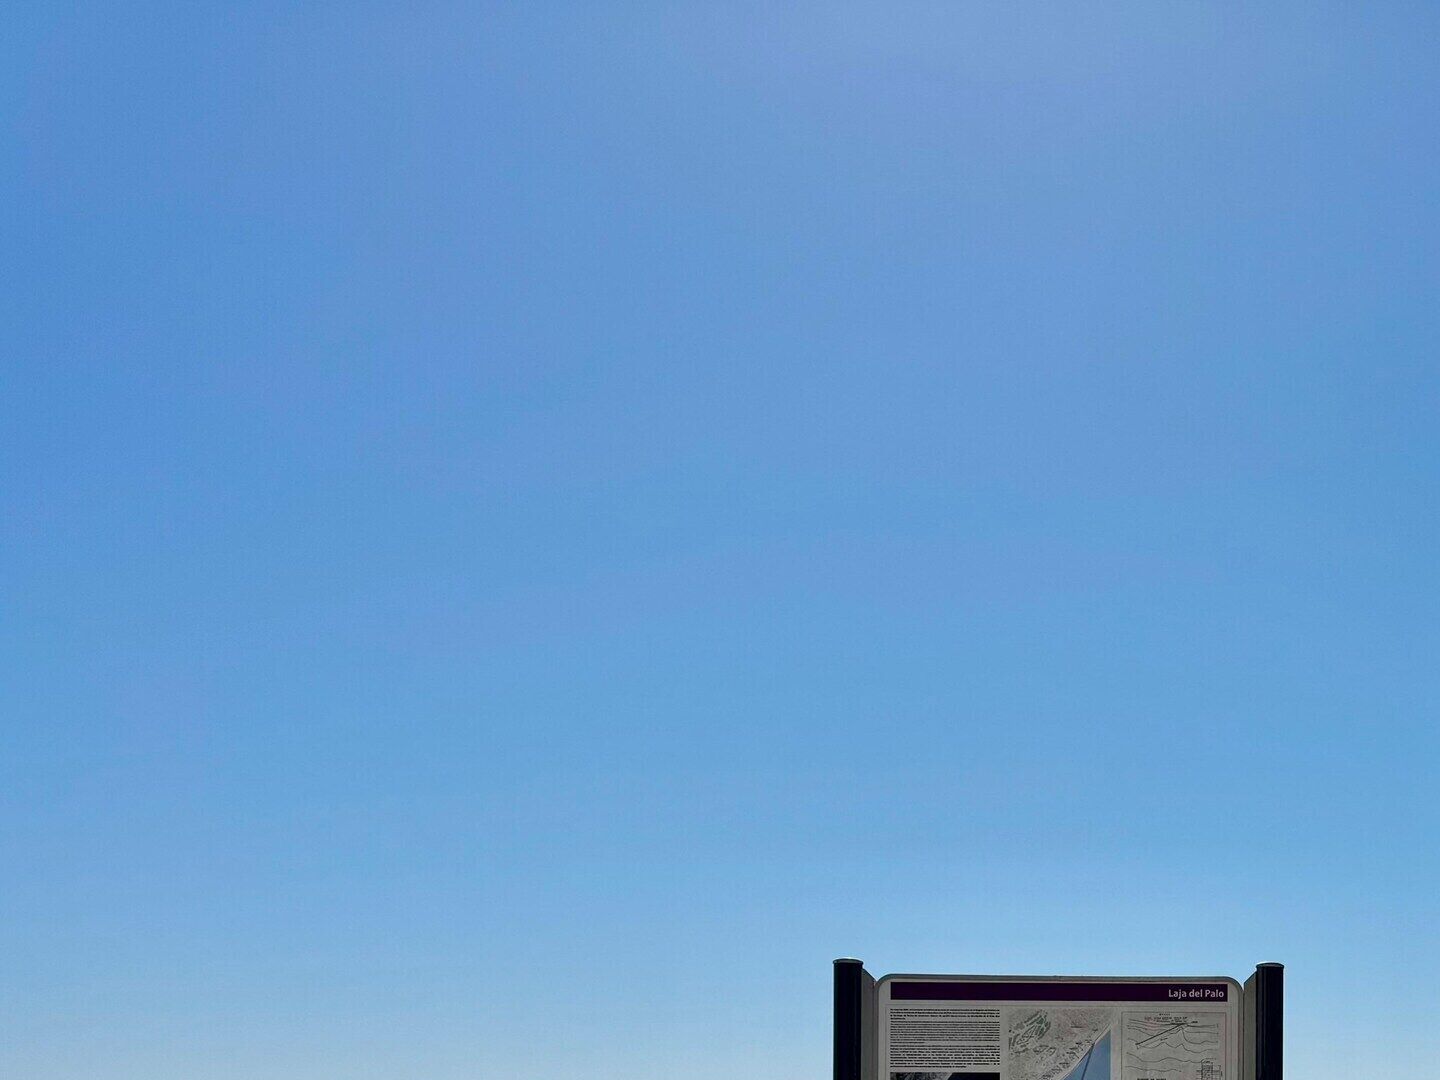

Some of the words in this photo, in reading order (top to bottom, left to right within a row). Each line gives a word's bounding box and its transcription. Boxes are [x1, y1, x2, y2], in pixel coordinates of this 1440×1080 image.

[1168, 989, 1187, 999] Laja
[1189, 989, 1203, 998] del
[1204, 989, 1224, 998] Palo
